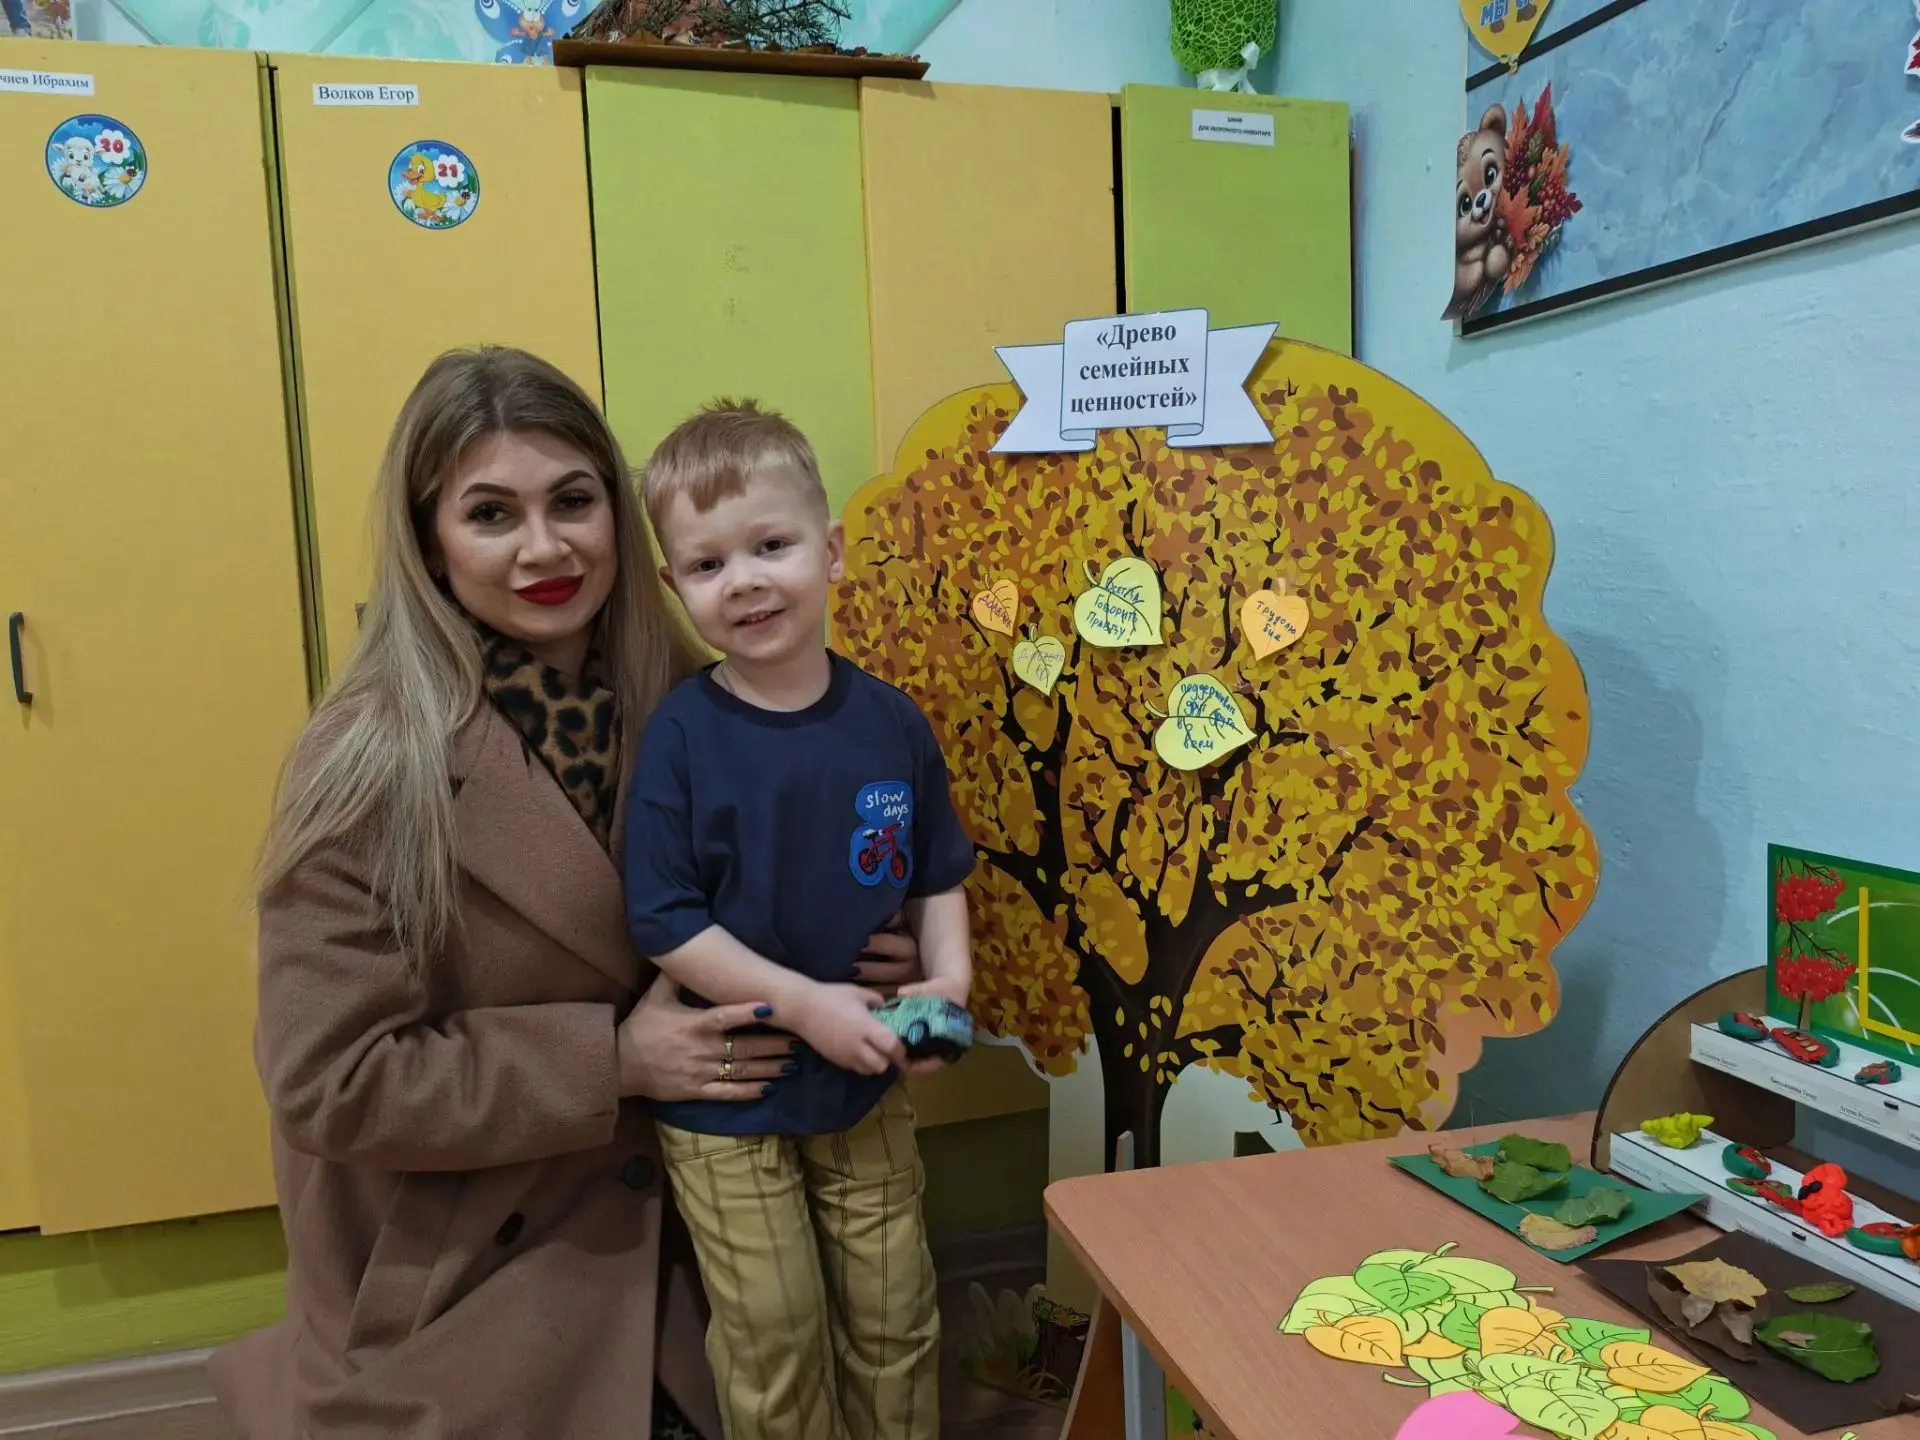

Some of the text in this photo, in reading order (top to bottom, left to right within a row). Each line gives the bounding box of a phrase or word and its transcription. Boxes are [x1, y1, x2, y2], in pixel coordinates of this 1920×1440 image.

[32, 74, 89, 88] Ибрахим
[319, 86, 414, 103] Волков Егор
[100, 138, 124, 154] 20
[438, 164, 458, 178] 21
[1096, 323, 1177, 351] «Древо
[1080, 356, 1190, 380] семейных
[1071, 386, 1197, 414] ценностей»
[865, 790, 905, 808] slow
